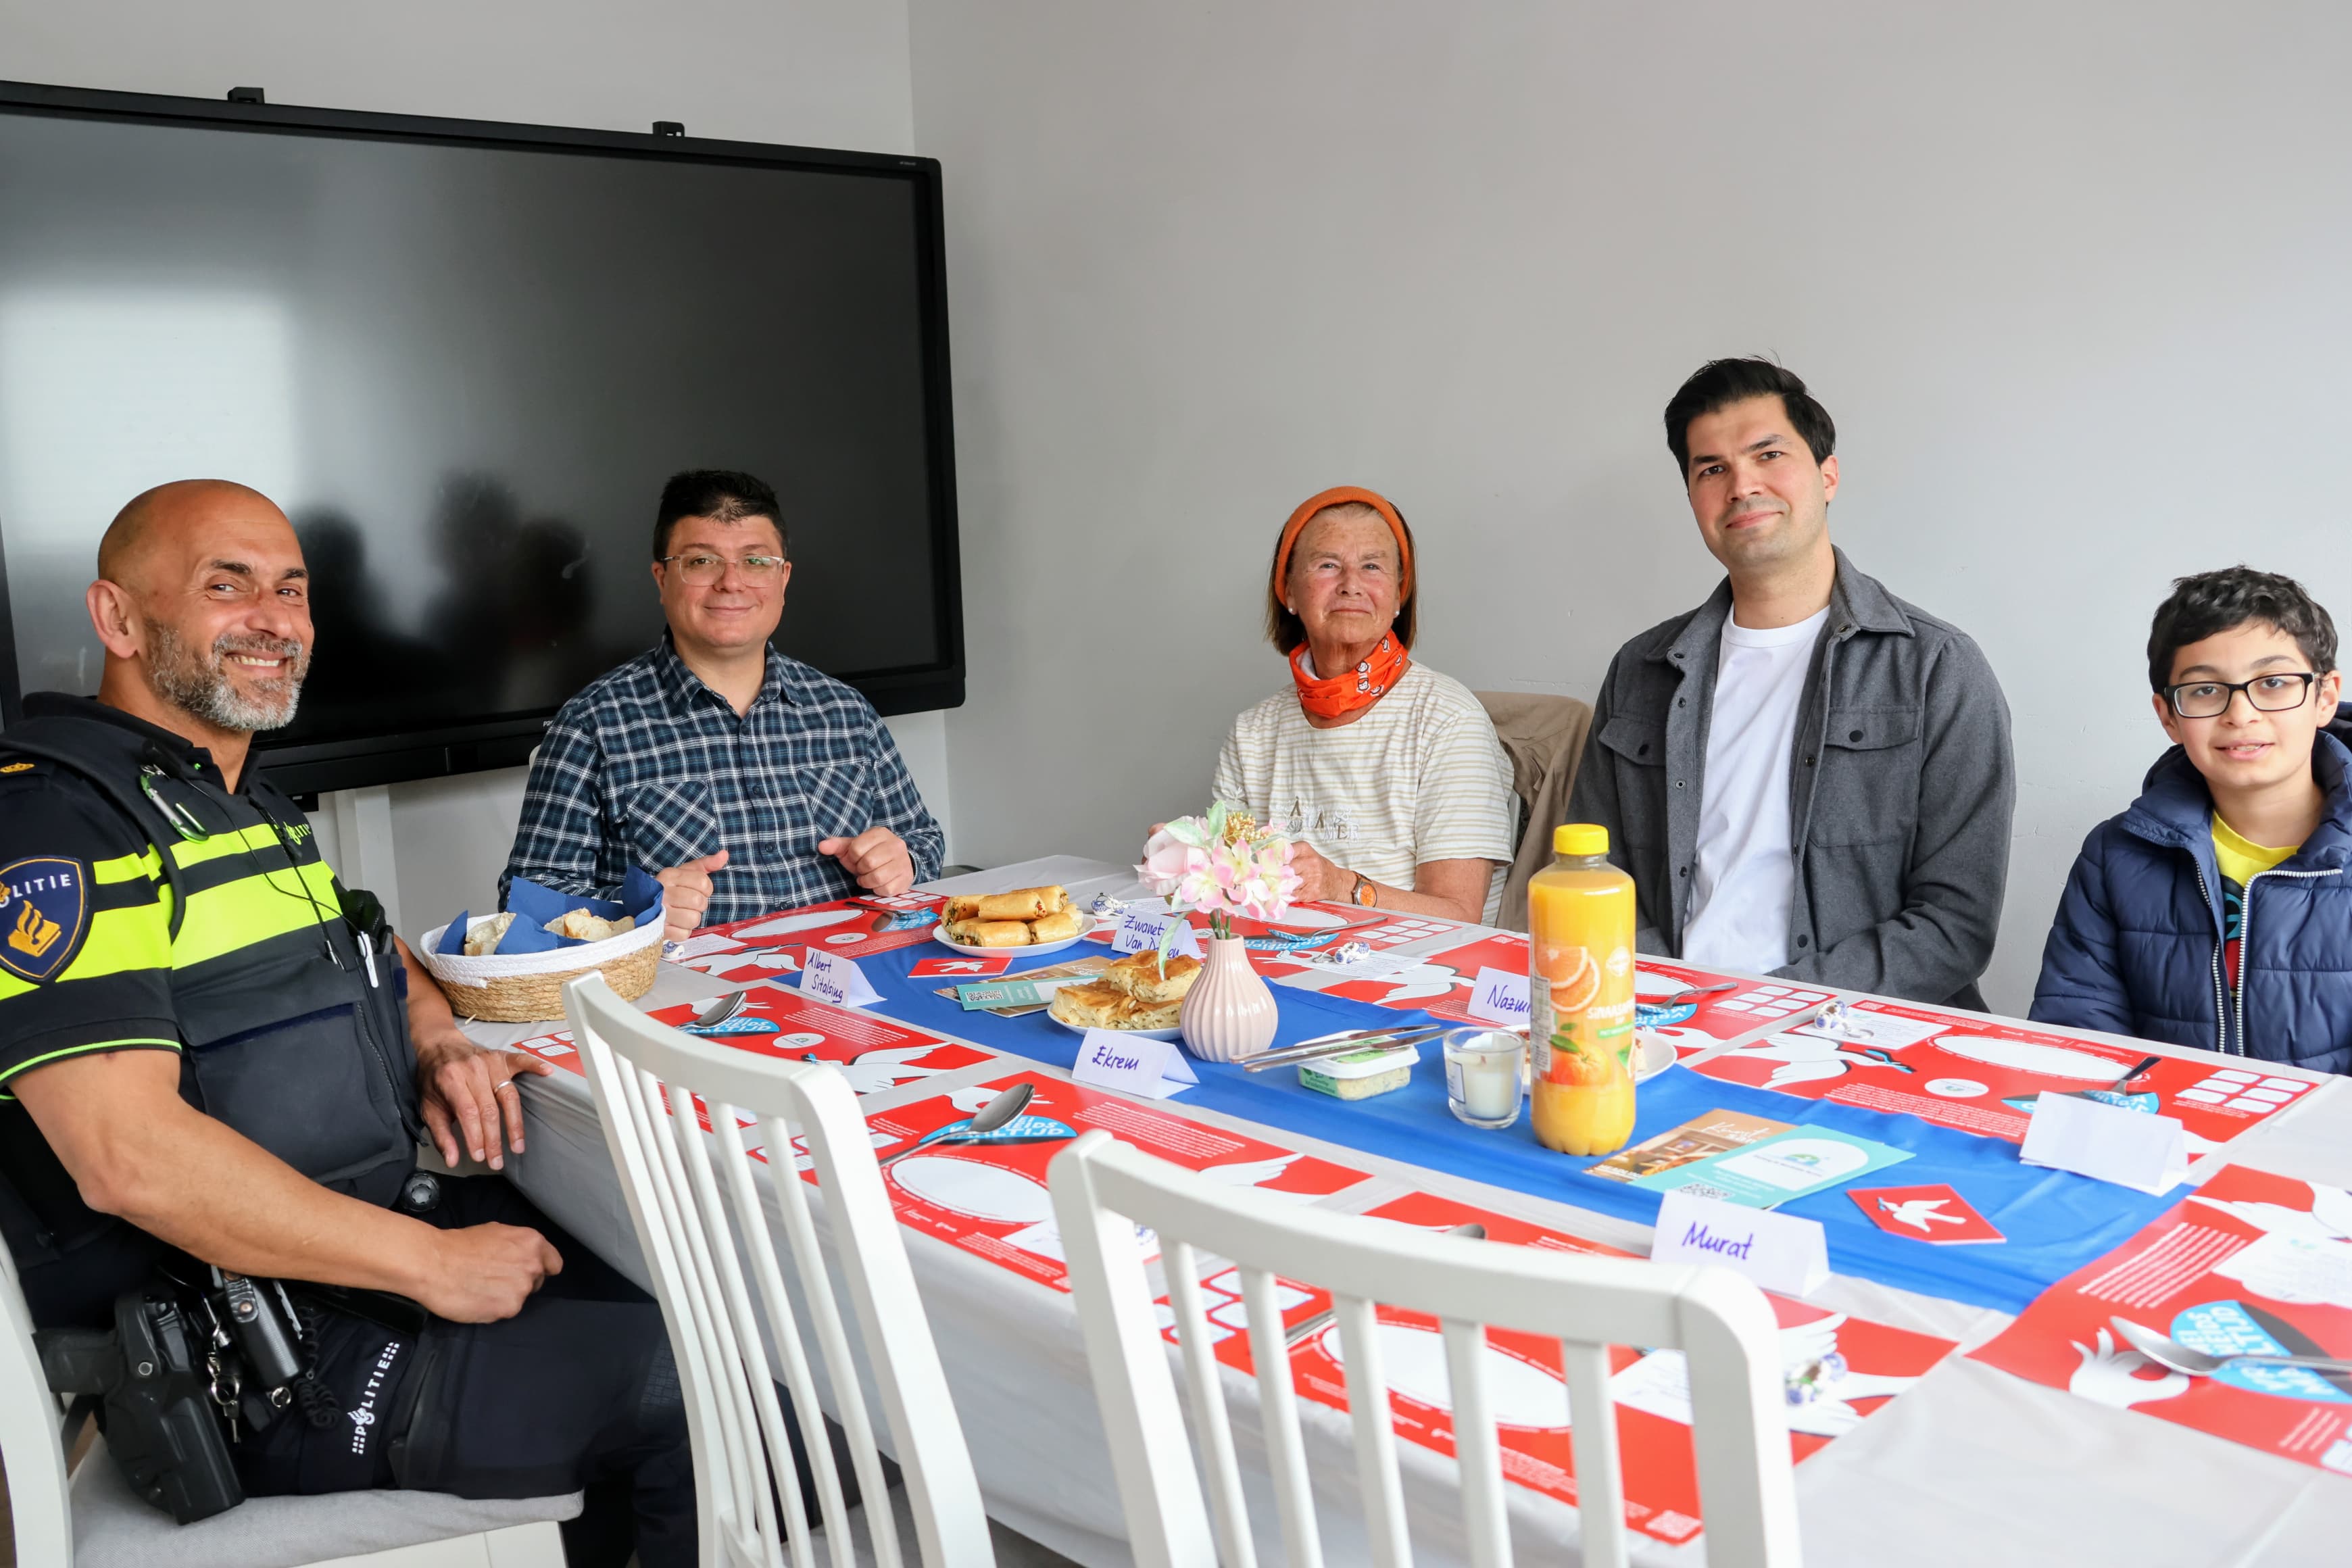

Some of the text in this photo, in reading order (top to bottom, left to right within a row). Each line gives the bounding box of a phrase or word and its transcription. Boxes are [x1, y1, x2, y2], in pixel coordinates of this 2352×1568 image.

[1124, 914, 1165, 936] Zwanet
[1125, 934, 1142, 950] Van
[808, 952, 832, 973] Albert
[811, 974, 843, 1003] Sitalsing
[1092, 1045, 1140, 1070] Ekrem
[1682, 1221, 1754, 1260] Murat
